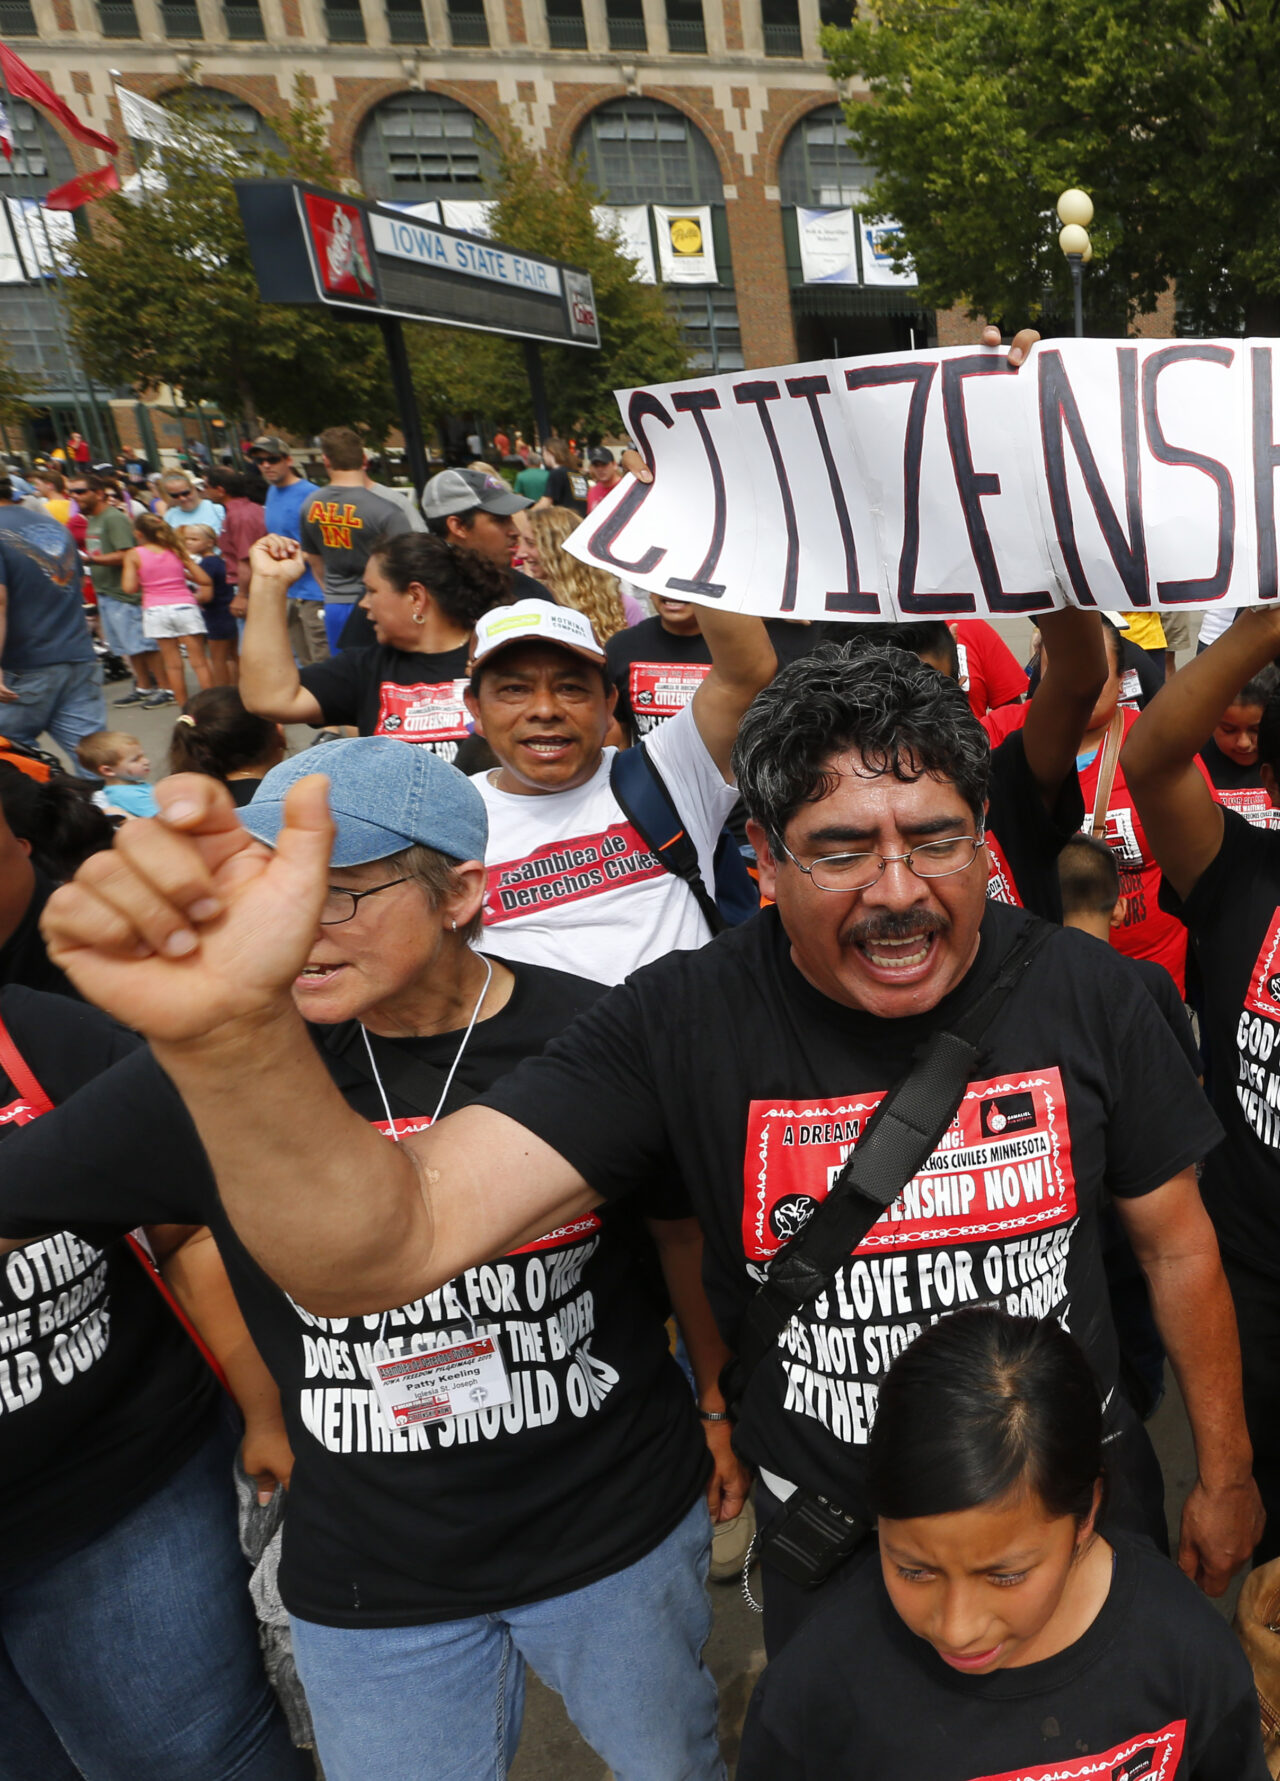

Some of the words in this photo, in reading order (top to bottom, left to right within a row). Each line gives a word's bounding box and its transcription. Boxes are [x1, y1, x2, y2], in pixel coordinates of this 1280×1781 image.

[390, 221, 448, 264] IOWA
[456, 242, 507, 278] STATE
[514, 258, 548, 289] FAIR
[308, 501, 364, 529] ALL
[319, 525, 353, 549] IN
[404, 713, 461, 731] CITIZENSHIP
[497, 846, 597, 888] Asamblea
[601, 835, 627, 858] de
[501, 867, 603, 911] Derechos
[782, 1125, 794, 1146] A
[798, 1117, 860, 1145] DREAM
[951, 1148, 988, 1170] CIVILES
[989, 1136, 1048, 1163] MINNESOTA
[983, 1156, 1056, 1212] NOW!
[464, 1263, 522, 1316] FOR
[834, 1256, 914, 1321] LOVE
[917, 1251, 979, 1310] FOR
[982, 1216, 1081, 1296] OTHERS
[0, 1308, 32, 1354] HE
[301, 1334, 356, 1380] DOES
[505, 1319, 547, 1363] THE
[810, 1323, 860, 1375] NOT
[383, 1378, 400, 1386] IOWA
[402, 1369, 433, 1382] FREEDOM
[435, 1358, 476, 1373] PILGRIMAGE
[406, 1378, 436, 1391] Patty
[438, 1367, 481, 1382] Keeling
[414, 1388, 439, 1399] Iglesia
[441, 1384, 450, 1393] St.
[452, 1378, 479, 1391] Joseph
[437, 1370, 560, 1448] SHOULD
